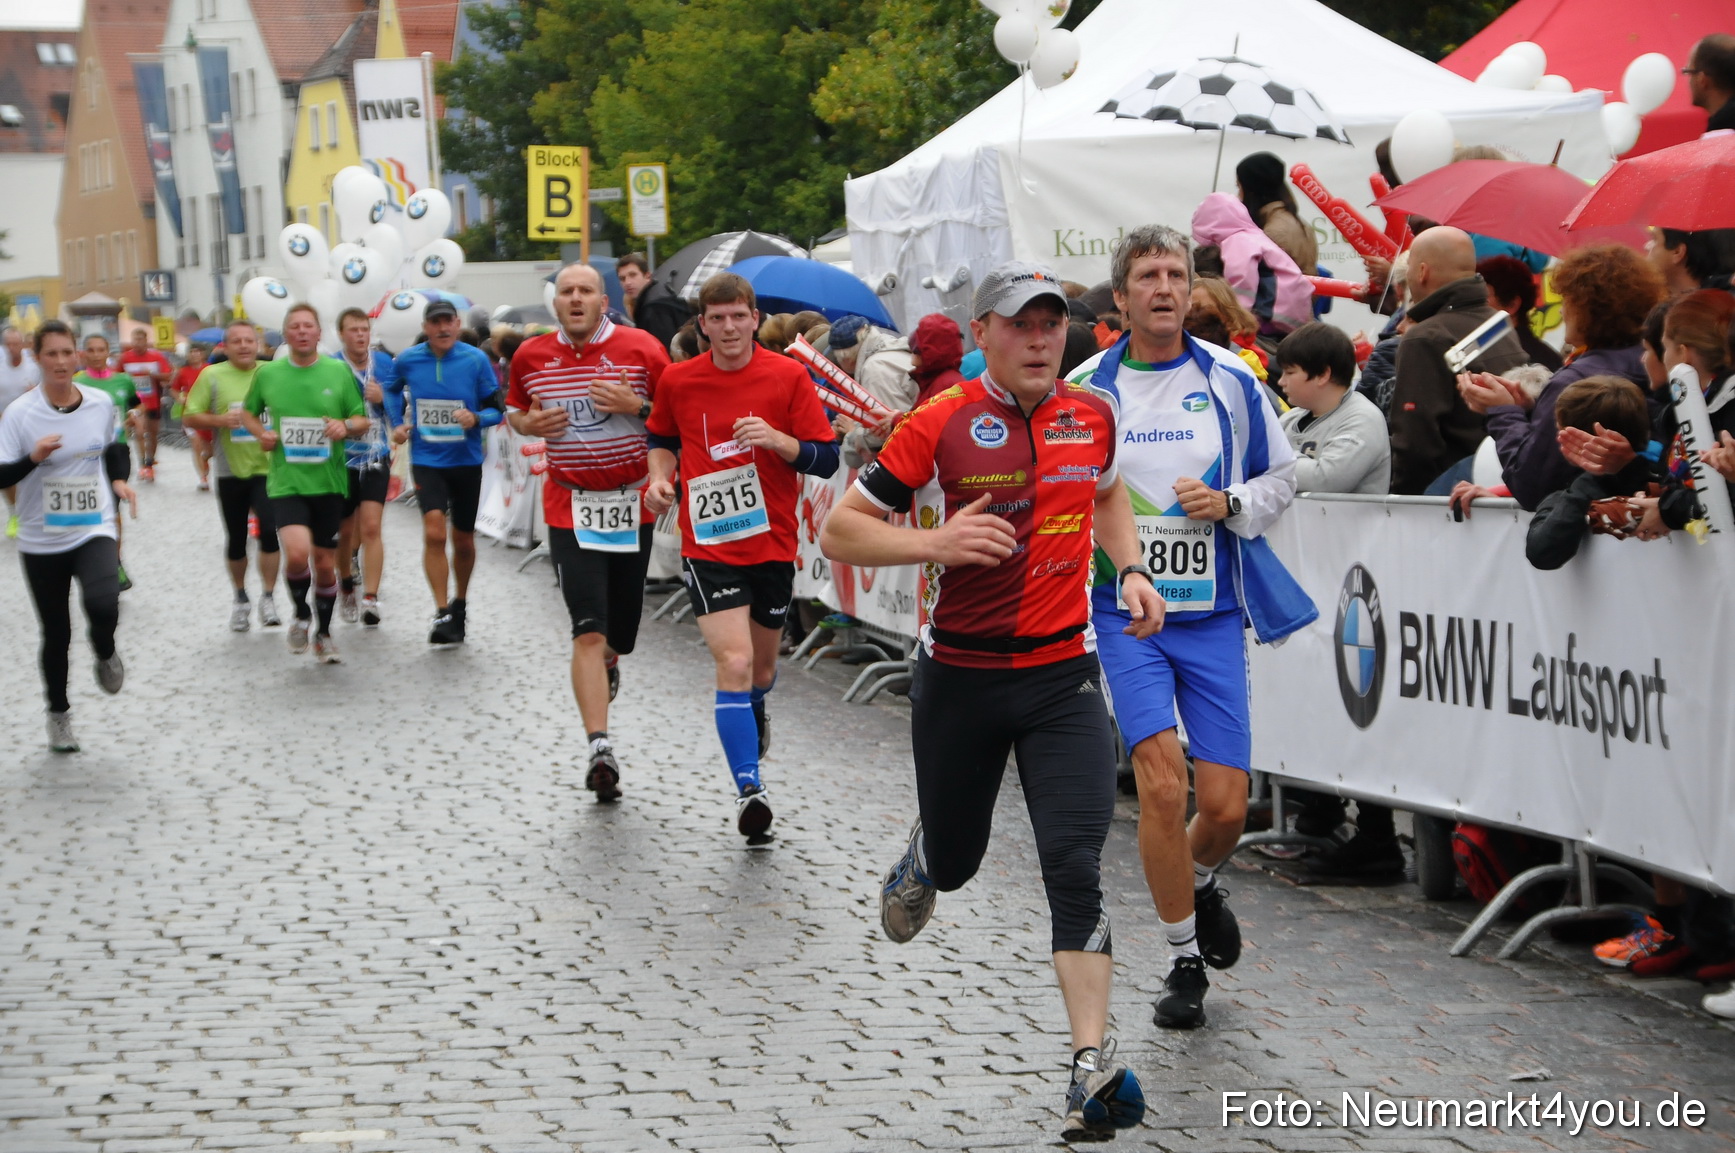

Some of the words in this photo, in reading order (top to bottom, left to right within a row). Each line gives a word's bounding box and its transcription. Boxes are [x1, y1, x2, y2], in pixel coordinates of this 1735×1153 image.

[535, 150, 581, 167] Block
[640, 174, 653, 189] H
[545, 174, 572, 217] B
[1053, 226, 1123, 257] Kind
[284, 428, 326, 446] 2872
[1044, 428, 1092, 440] Bischofshof
[1123, 429, 1194, 444] Andreas
[690, 483, 709, 492] PARTL
[710, 474, 746, 487] Neumarkt
[961, 474, 1014, 483] stadler
[50, 489, 97, 511] 3196
[696, 482, 756, 519] 2315
[580, 505, 633, 528] 3134
[712, 518, 751, 534] Andreas
[1155, 526, 1202, 535] Neumarkt
[1400, 611, 1497, 710] BMW
[1507, 622, 1671, 760] Laufsport
